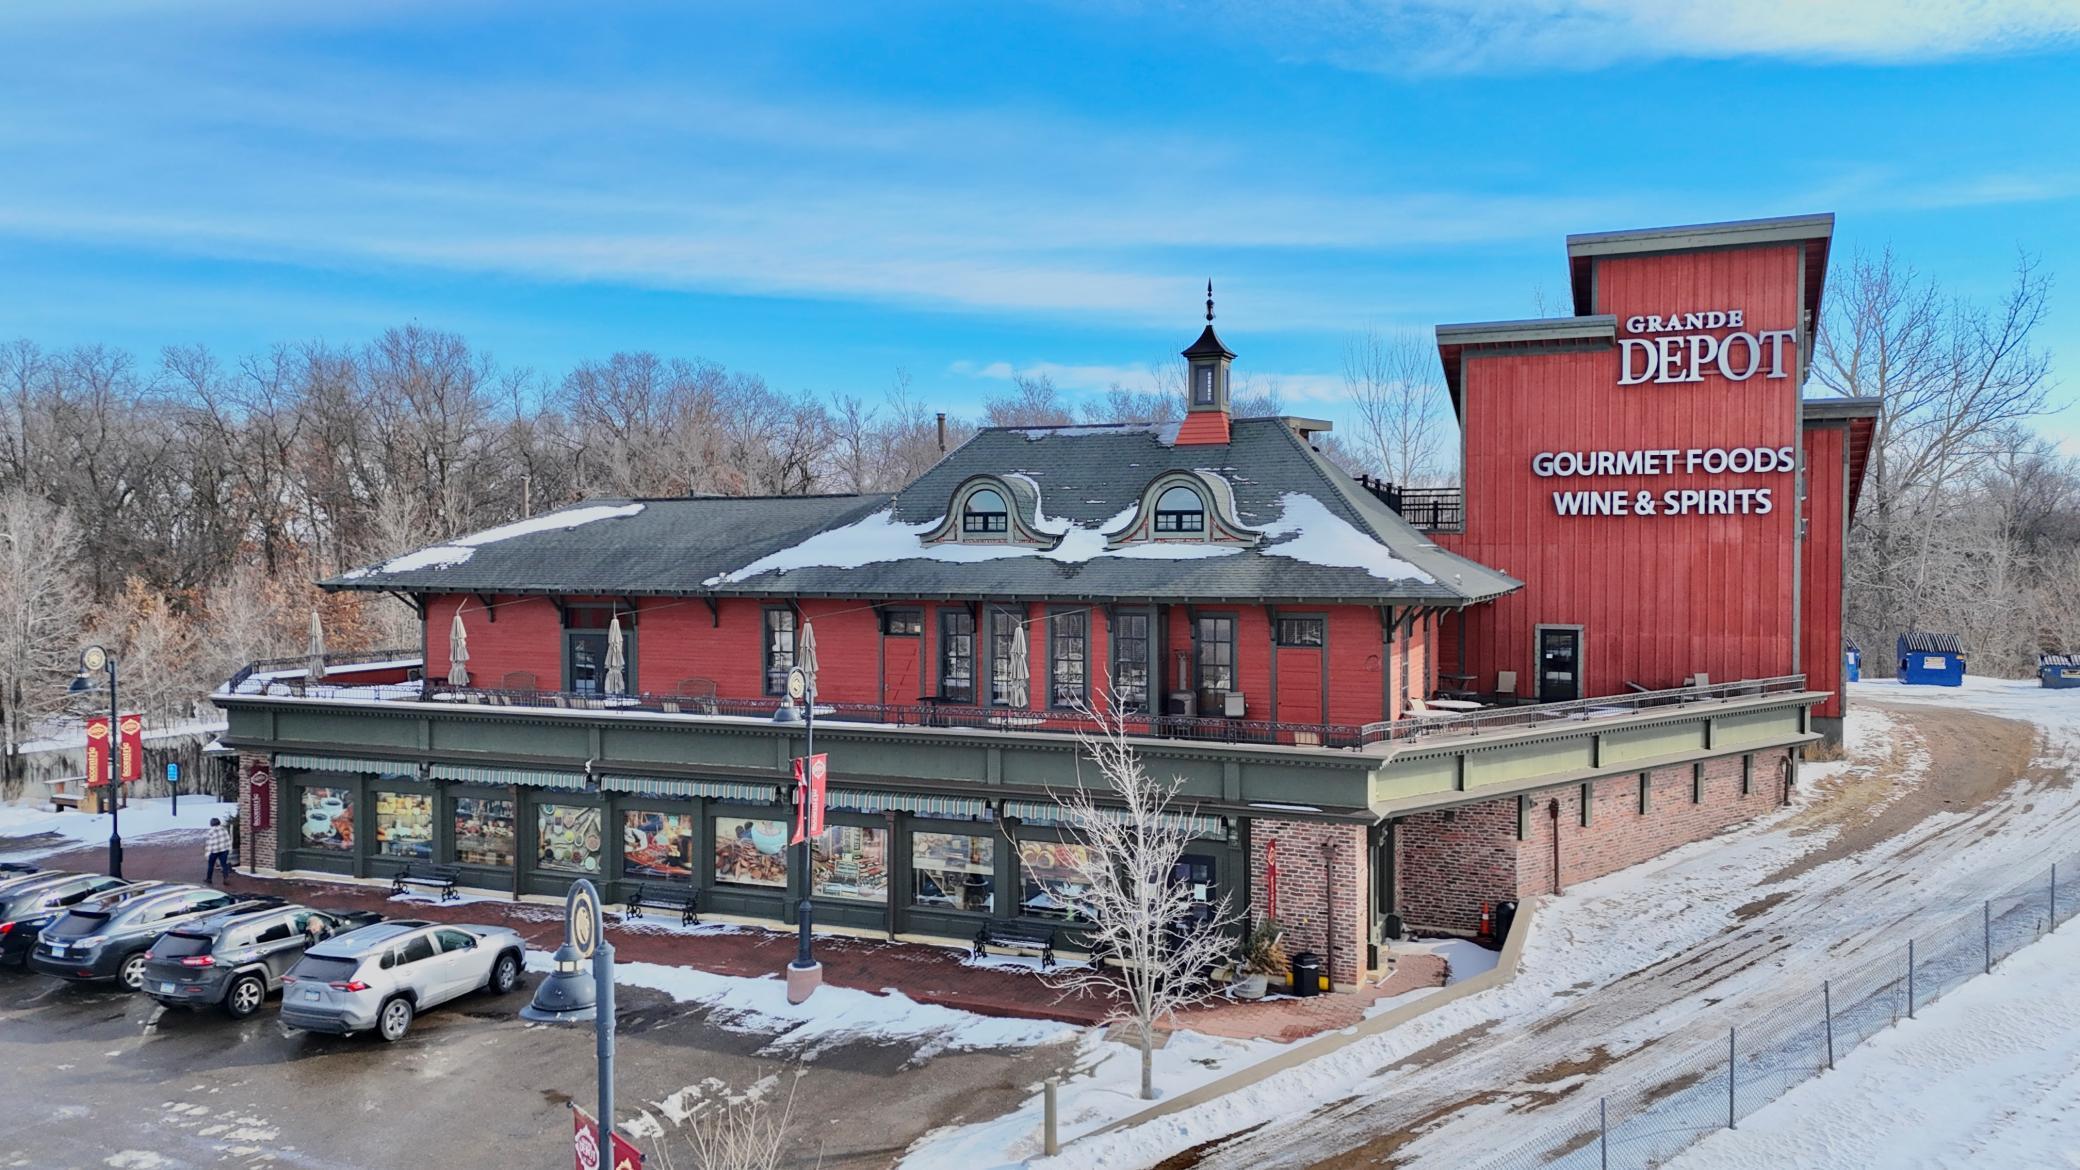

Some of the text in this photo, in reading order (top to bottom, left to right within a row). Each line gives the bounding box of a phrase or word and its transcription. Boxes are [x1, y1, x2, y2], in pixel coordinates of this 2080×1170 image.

[1626, 310, 1743, 333] GRANDE
[1617, 328, 1796, 384] DEPOT
[1533, 447, 1795, 476] GOURMET FOODS
[1553, 489, 1772, 515] WINE & SPIRITS
